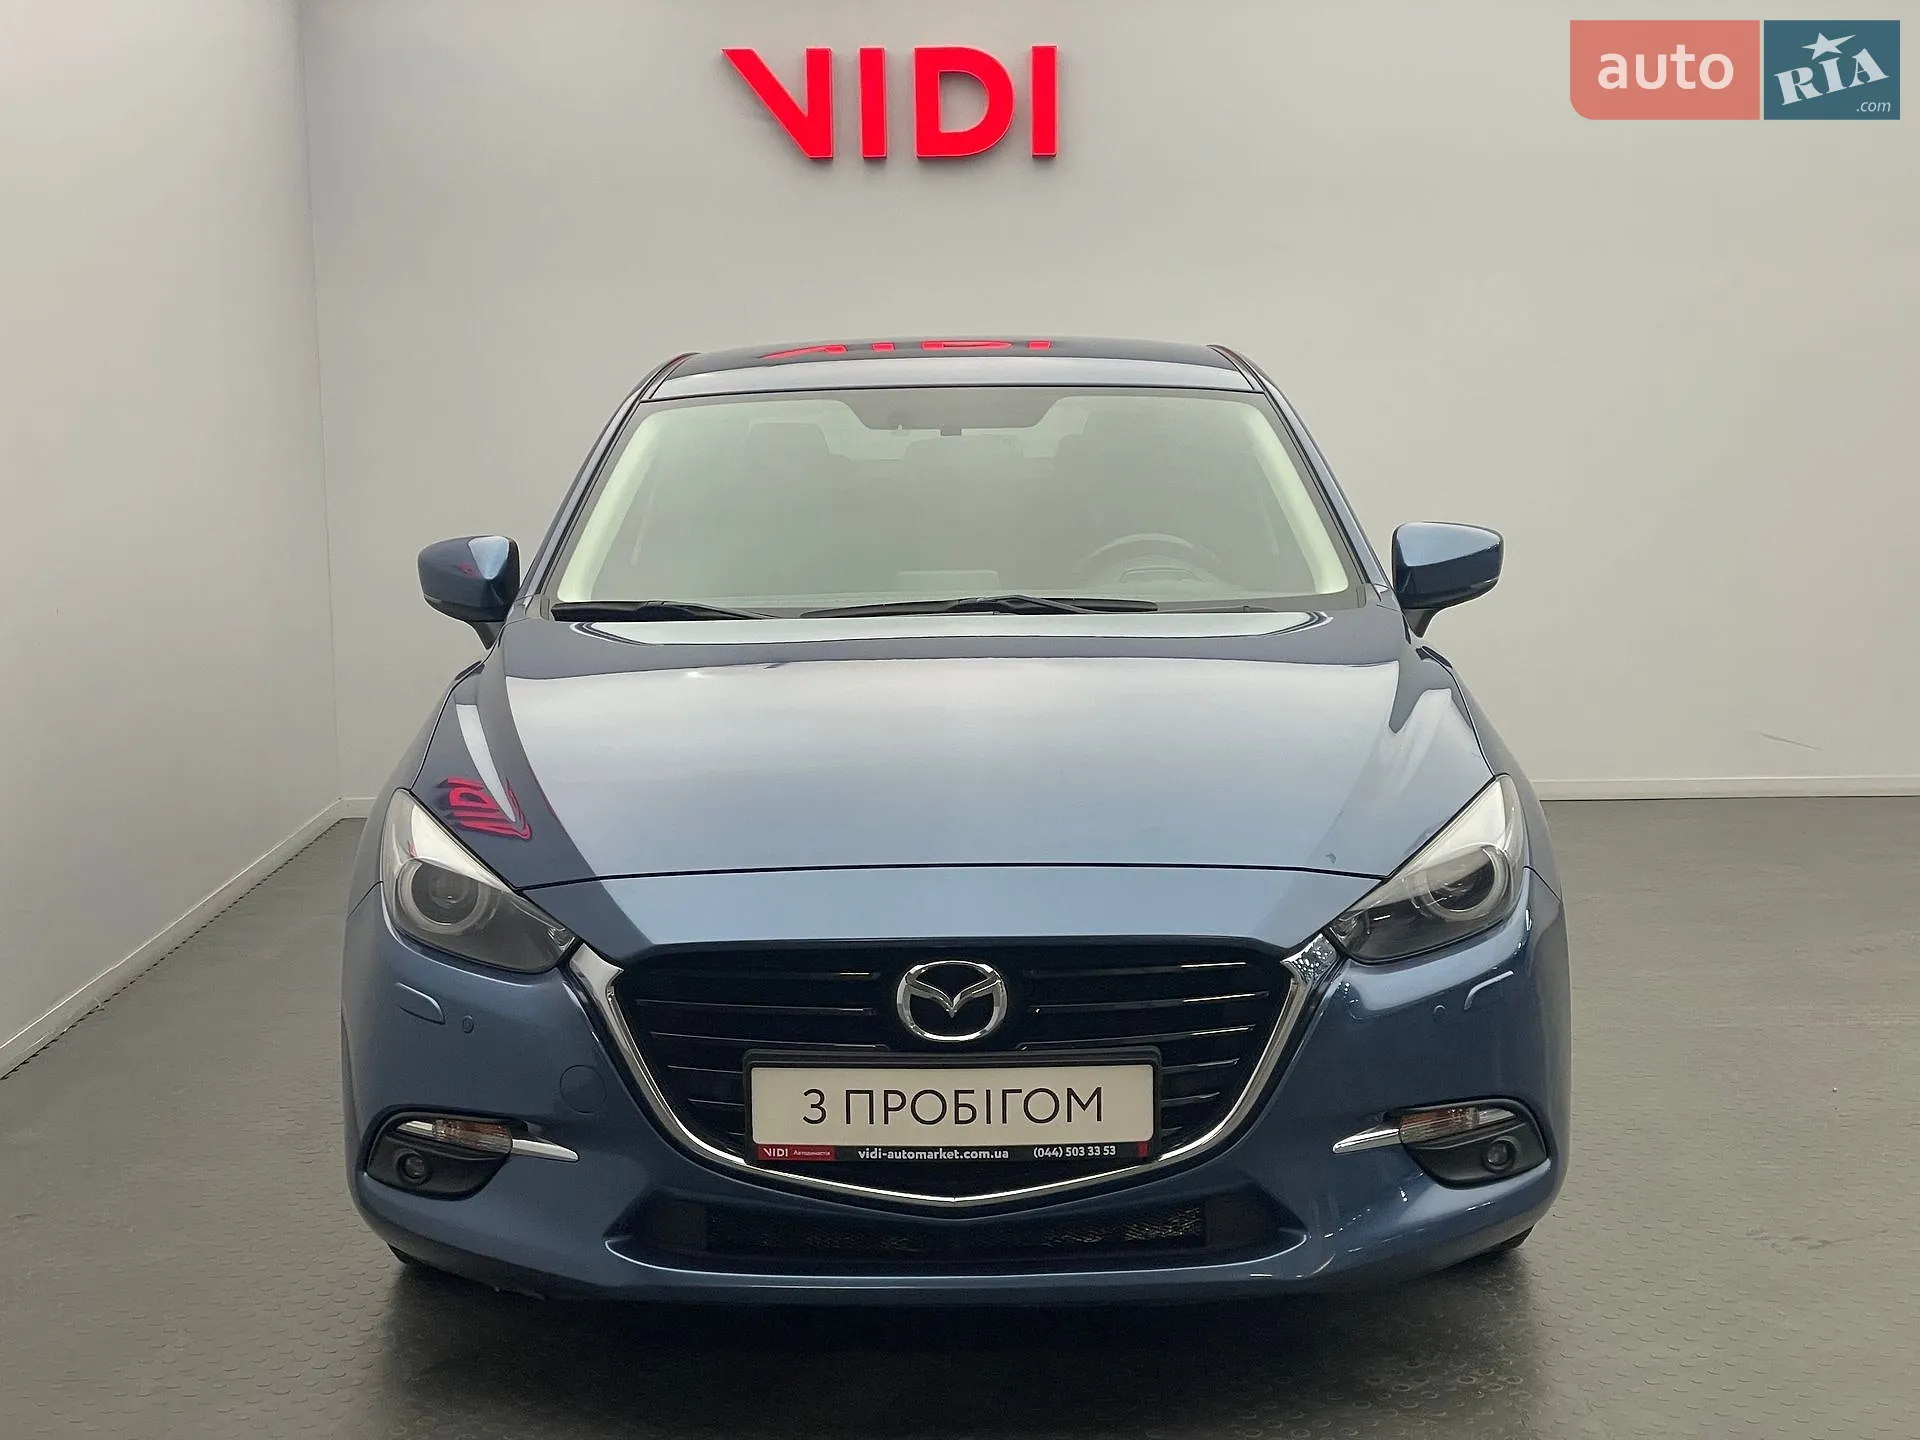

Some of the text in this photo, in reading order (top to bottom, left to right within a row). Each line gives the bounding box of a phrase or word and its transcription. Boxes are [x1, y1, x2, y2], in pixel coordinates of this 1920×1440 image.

[721, 45, 1057, 158] VIDI
[845, 1086, 1102, 1125] ПРОБІГОМ
[763, 1147, 789, 1158] VIDI
[858, 1147, 1009, 1160] vidi-automarket.com.ua
[1033, 1145, 1116, 1158] (044) 503 33 53
